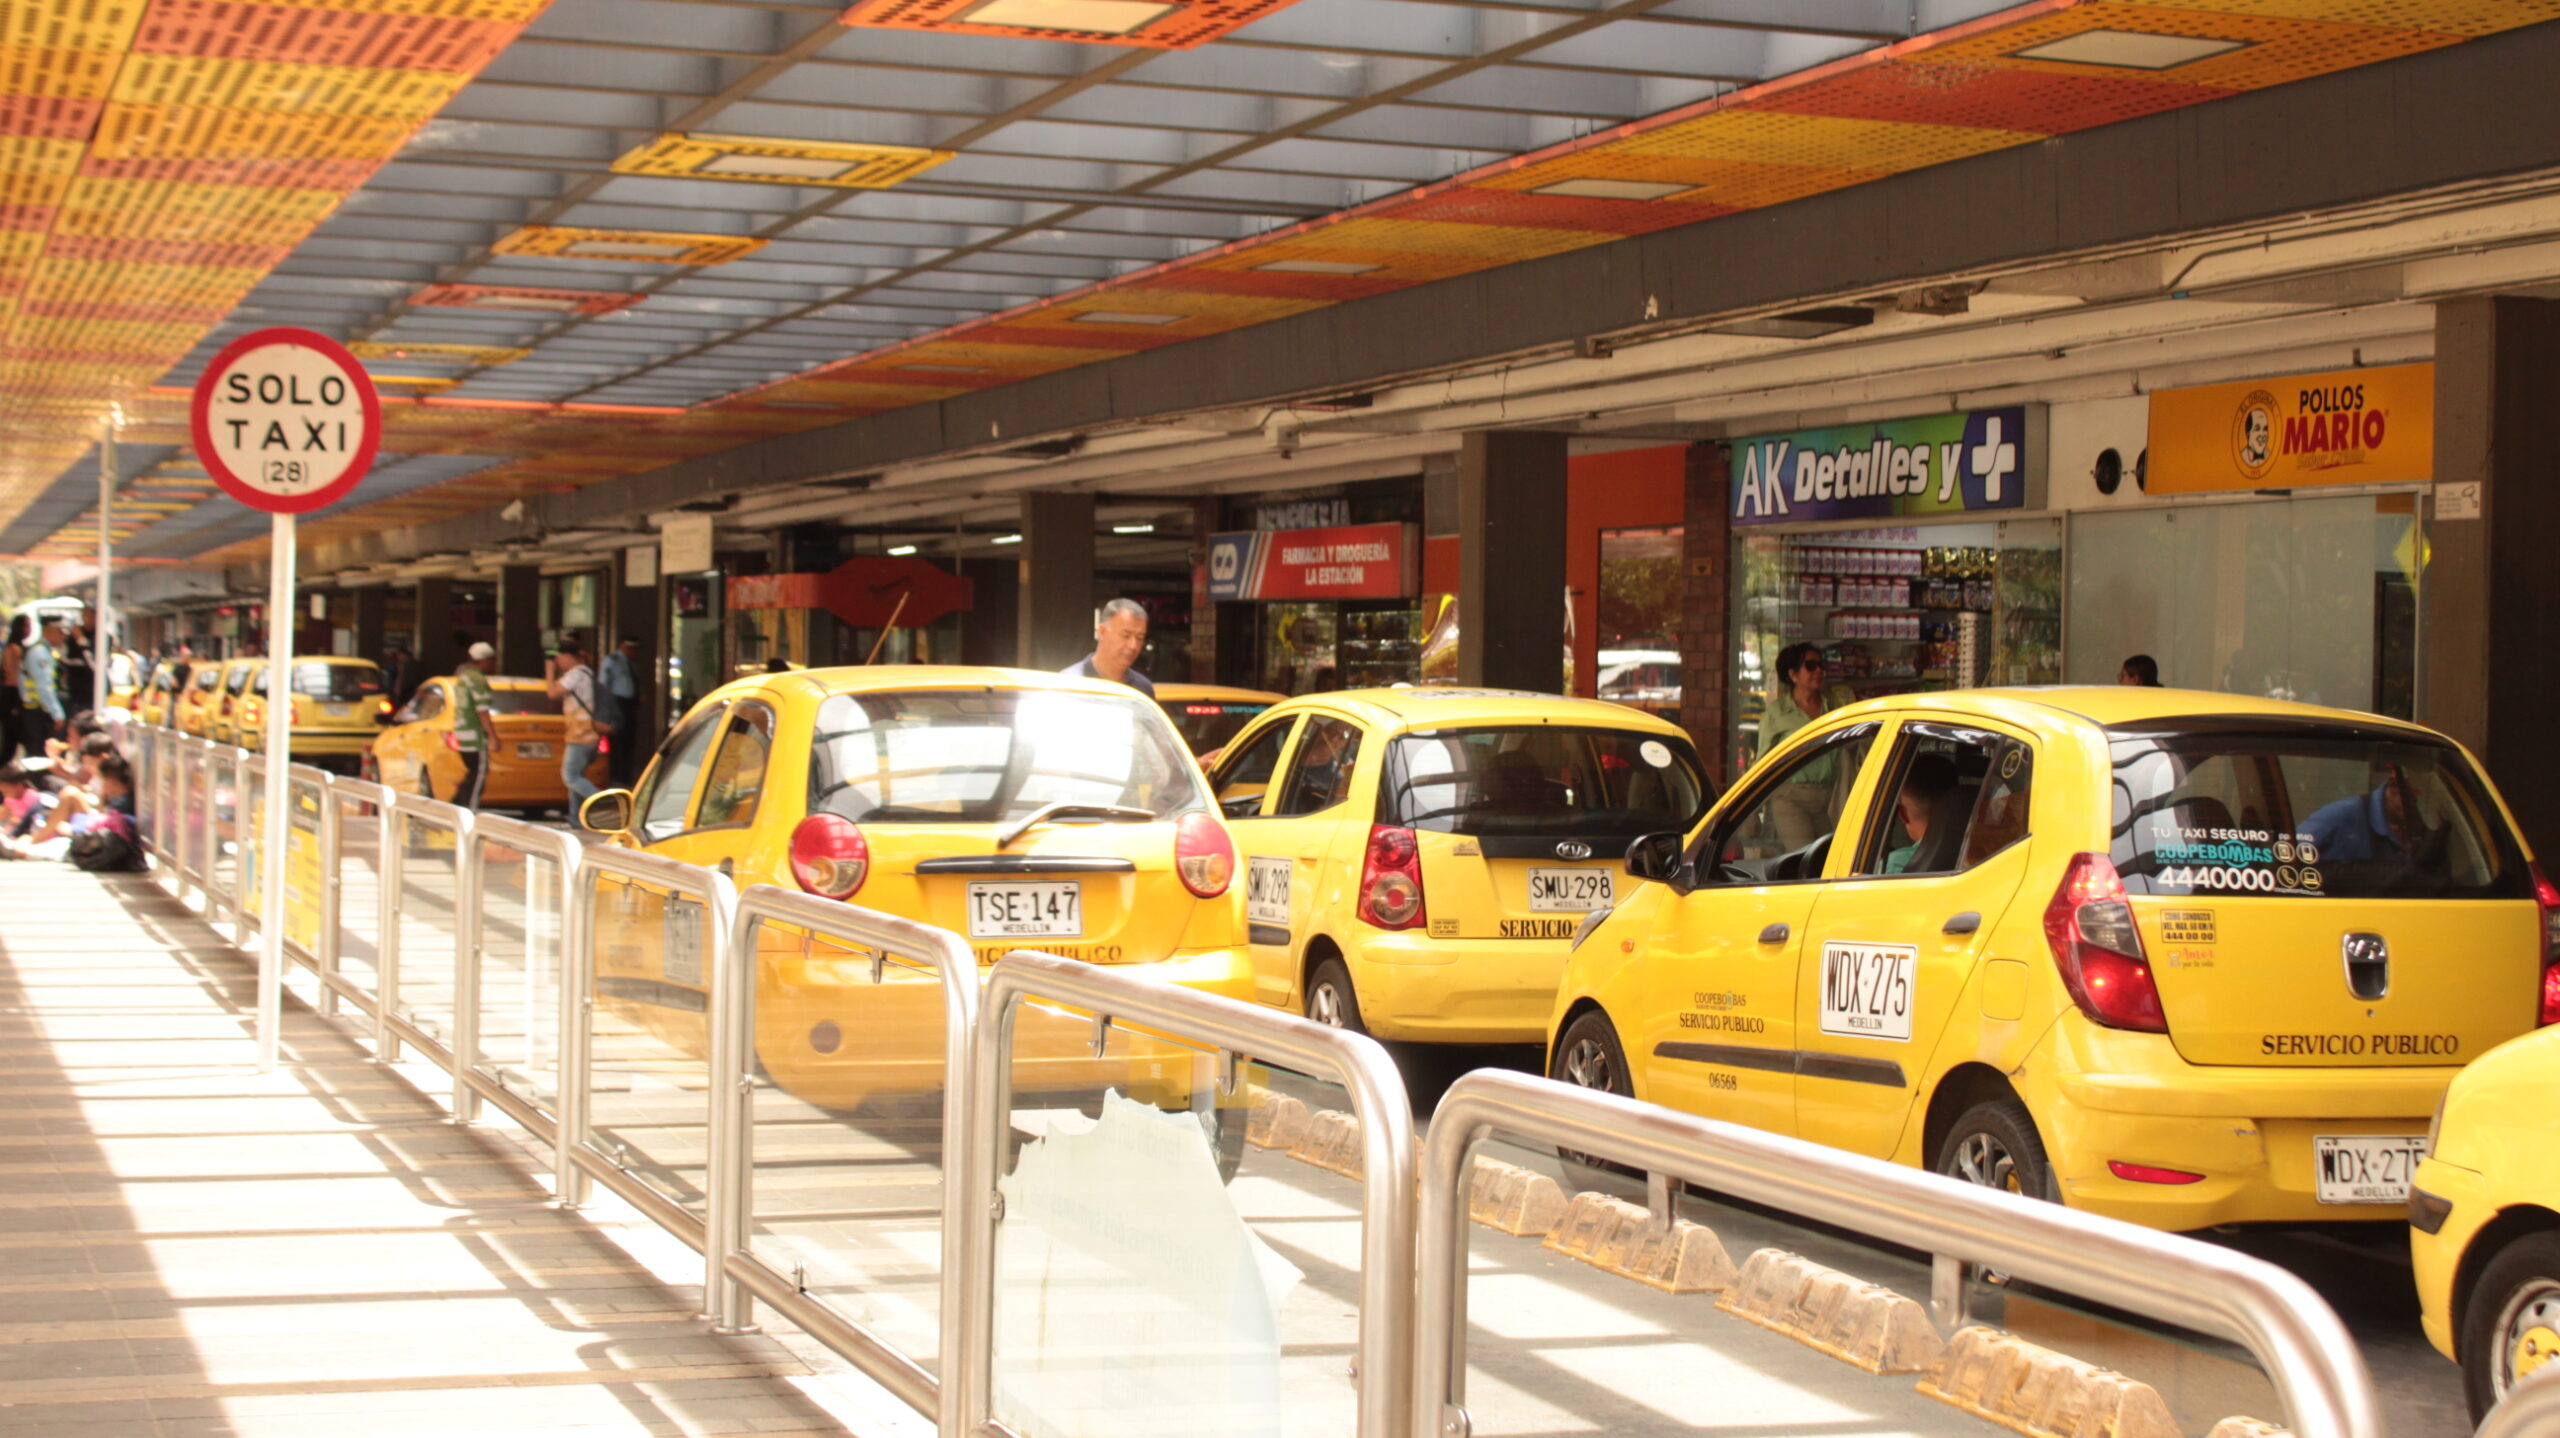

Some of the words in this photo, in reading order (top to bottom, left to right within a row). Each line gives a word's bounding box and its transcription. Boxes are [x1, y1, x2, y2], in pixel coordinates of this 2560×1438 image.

[228, 373, 345, 406] SOLO
[2299, 384, 2365, 414] POLLOS
[226, 417, 345, 452] TAXI
[2283, 409, 2385, 455] MARIO
[262, 459, 309, 484] (28)
[1735, 440, 1790, 518] AK
[1793, 438, 1931, 503] Detalles
[1937, 441, 1964, 504] y
[1282, 546, 1326, 565] FARMACIA
[1327, 545, 1335, 563] Y
[1305, 567, 1317, 586] LA
[1318, 563, 1364, 585] ESTACIÓN
[2151, 827, 2171, 839] TU
[2178, 827, 2207, 839] TAXI
[2210, 828, 2269, 842] SEGURO
[2154, 842, 2273, 864] COOPEBOMBAS
[2158, 865, 2275, 892] 4440000
[1003, 923, 1051, 934] MEDELLIN
[2165, 932, 2184, 940] 444
[1679, 1012, 1721, 1031] SERVICIO
[1722, 1015, 1765, 1034] PUBLICO
[1847, 1016, 1882, 1030] MEDELLIN
[2261, 1034, 2365, 1055] SERVICIO
[2370, 1034, 2460, 1055] PUBLICO
[1708, 1072, 1738, 1091] 06568
[2352, 1186, 2404, 1197] MEDELLIN
